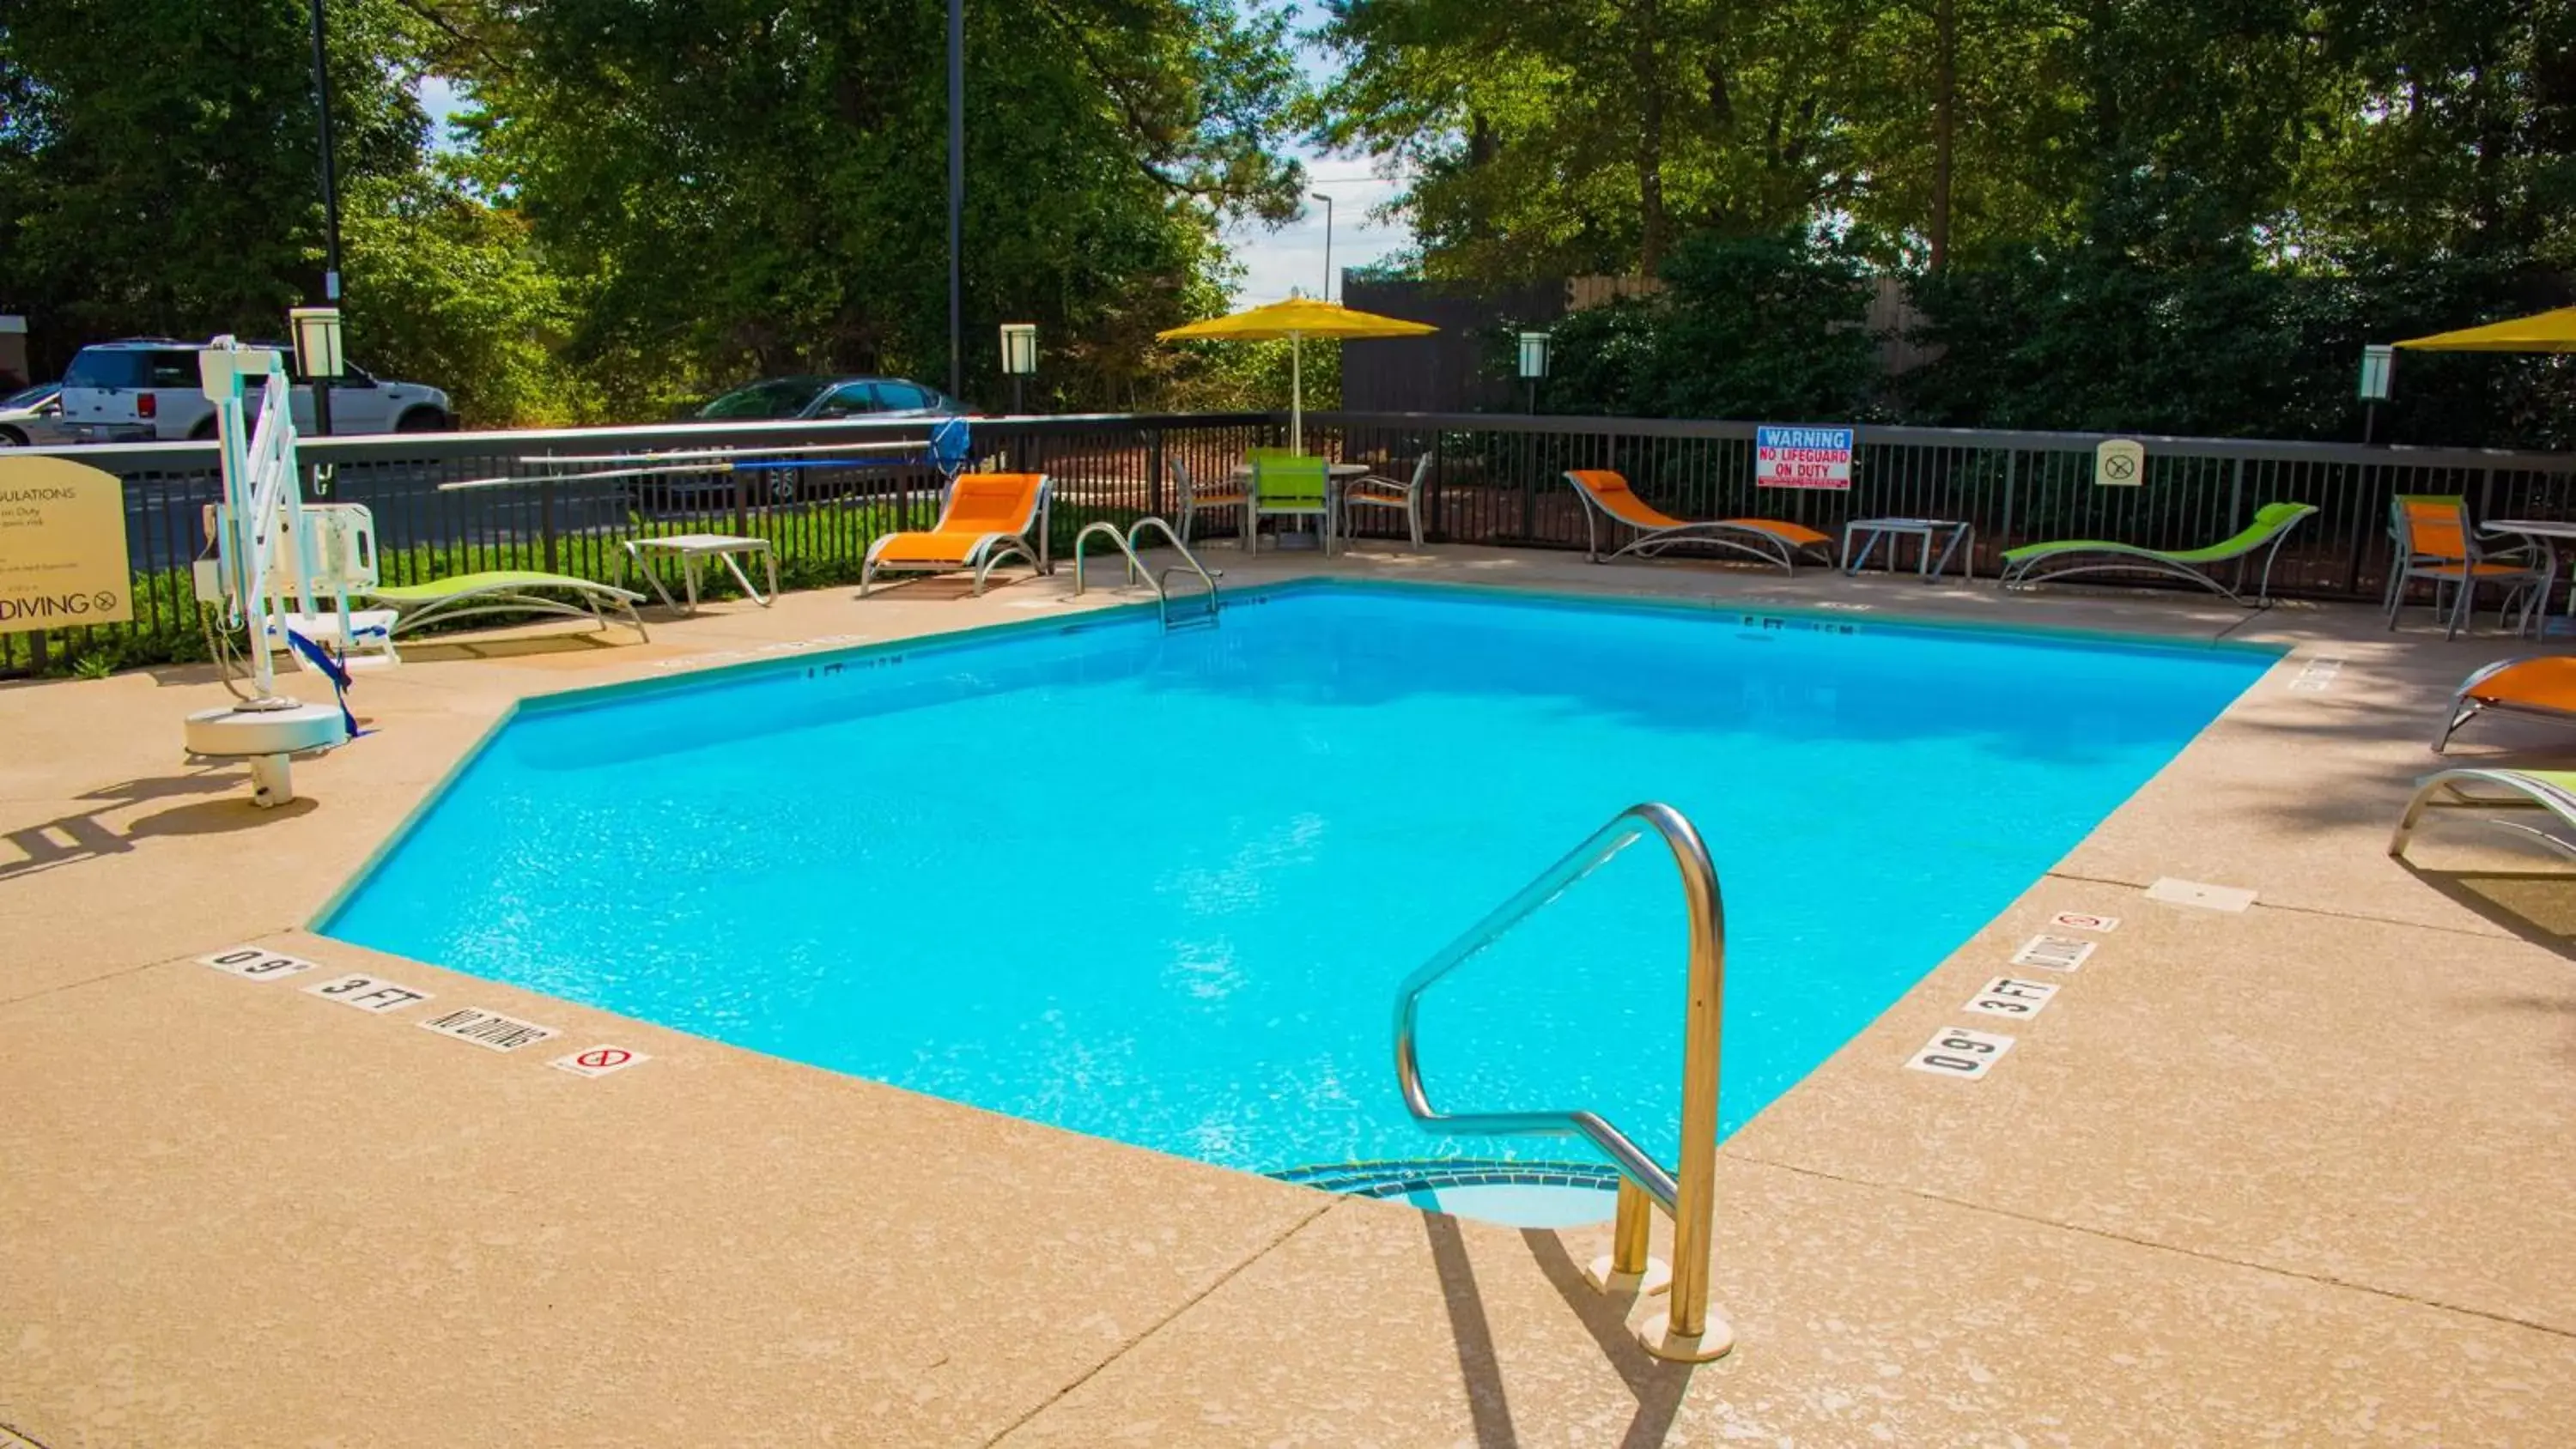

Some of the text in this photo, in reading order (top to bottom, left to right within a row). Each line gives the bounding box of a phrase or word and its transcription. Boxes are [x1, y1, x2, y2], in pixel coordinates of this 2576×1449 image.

[1765, 430, 1844, 448] WARNING
[1759, 447, 1849, 463] NO LIFEGUARD
[1775, 463, 1831, 477] ON DUTY
[0, 487, 76, 502] ULATIONS
[0, 592, 89, 621] DIVING
[321, 979, 423, 1009] 3 FT
[1978, 979, 2050, 1014] 3 FT
